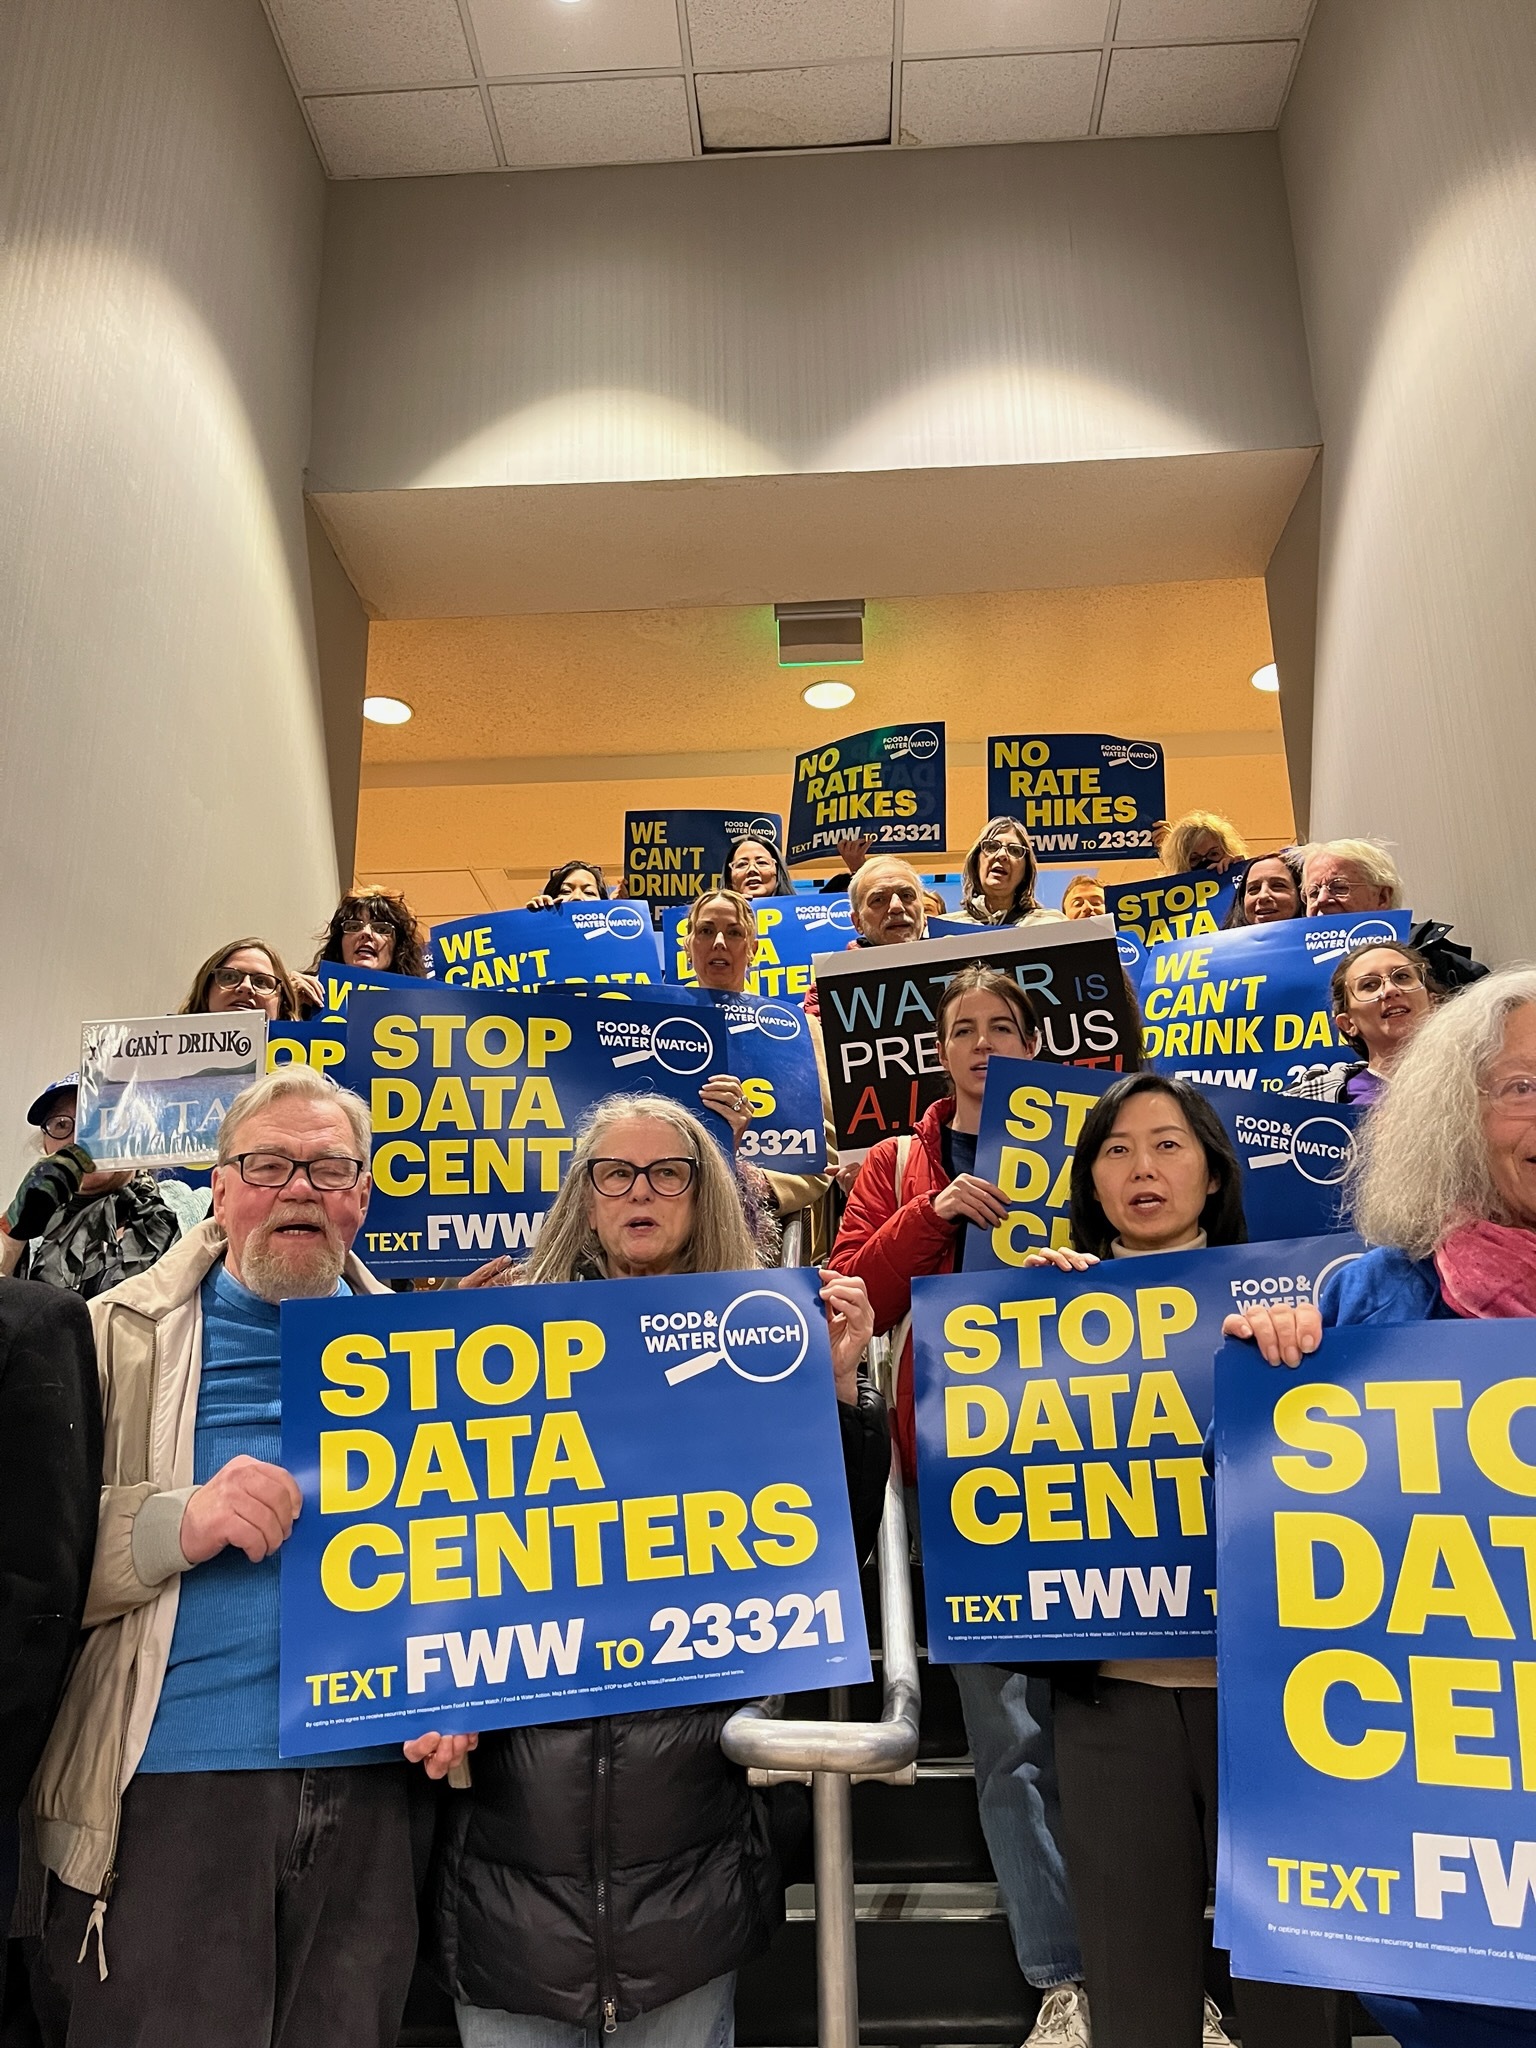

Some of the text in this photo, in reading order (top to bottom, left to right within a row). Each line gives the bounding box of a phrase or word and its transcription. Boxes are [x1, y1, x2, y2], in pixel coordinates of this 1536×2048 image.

[883, 740, 936, 750] WATER WATCH
[994, 740, 1050, 768] NO
[798, 747, 841, 782] NO
[806, 762, 882, 804] RATE
[1010, 767, 1101, 798] RATE
[815, 789, 918, 827] HIKES
[1026, 795, 1137, 828] HIKES
[630, 821, 668, 844] WE
[750, 828, 775, 836] WATCH
[791, 841, 812, 855] TEXT
[812, 826, 862, 849] FWW
[863, 832, 878, 843] TO
[879, 823, 940, 842] 23321
[1081, 839, 1097, 850] TO
[1098, 829, 1152, 849] 2332
[630, 847, 704, 871] CAN'T
[629, 873, 705, 897] DRINK
[1117, 880, 1220, 921] STOP
[574, 919, 641, 929] WATER WATCH
[797, 912, 827, 920] WATER
[438, 926, 496, 964] WE
[1305, 935, 1393, 951] WATER WATCH
[444, 948, 550, 990] CAN'T
[1155, 947, 1214, 985] WE
[1074, 973, 1109, 1002] IS
[1144, 975, 1266, 1021] CAN'T
[758, 1015, 797, 1028] WATCH
[1143, 1015, 1265, 1059] DRINK
[125, 1030, 173, 1058] CAN'T
[177, 1030, 251, 1057] DRINK
[371, 1015, 572, 1070] STOP
[599, 1034, 708, 1053] WATER WATCH
[840, 1009, 1119, 1083] PREUS
[371, 1075, 566, 1133] DATA
[1260, 1078, 1283, 1092] TO
[1236, 1129, 1352, 1161] WATER WATCH
[372, 1137, 576, 1197] CENT
[365, 1212, 545, 1253] TEXT FWW
[645, 1323, 801, 1354] WATER WATCH
[943, 1285, 1198, 1375] STOP
[319, 1319, 607, 1418] STOP
[944, 1370, 1204, 1459] DATA
[319, 1410, 606, 1515] DATA
[950, 1457, 1208, 1546] CENT
[320, 1482, 820, 1614] CENTERS
[945, 1594, 1023, 1624] TEXT
[1028, 1565, 1192, 1621] FWW
[306, 1589, 846, 1706] TEXT FWW TO 23321
[1268, 1857, 1400, 1915] TEXT
